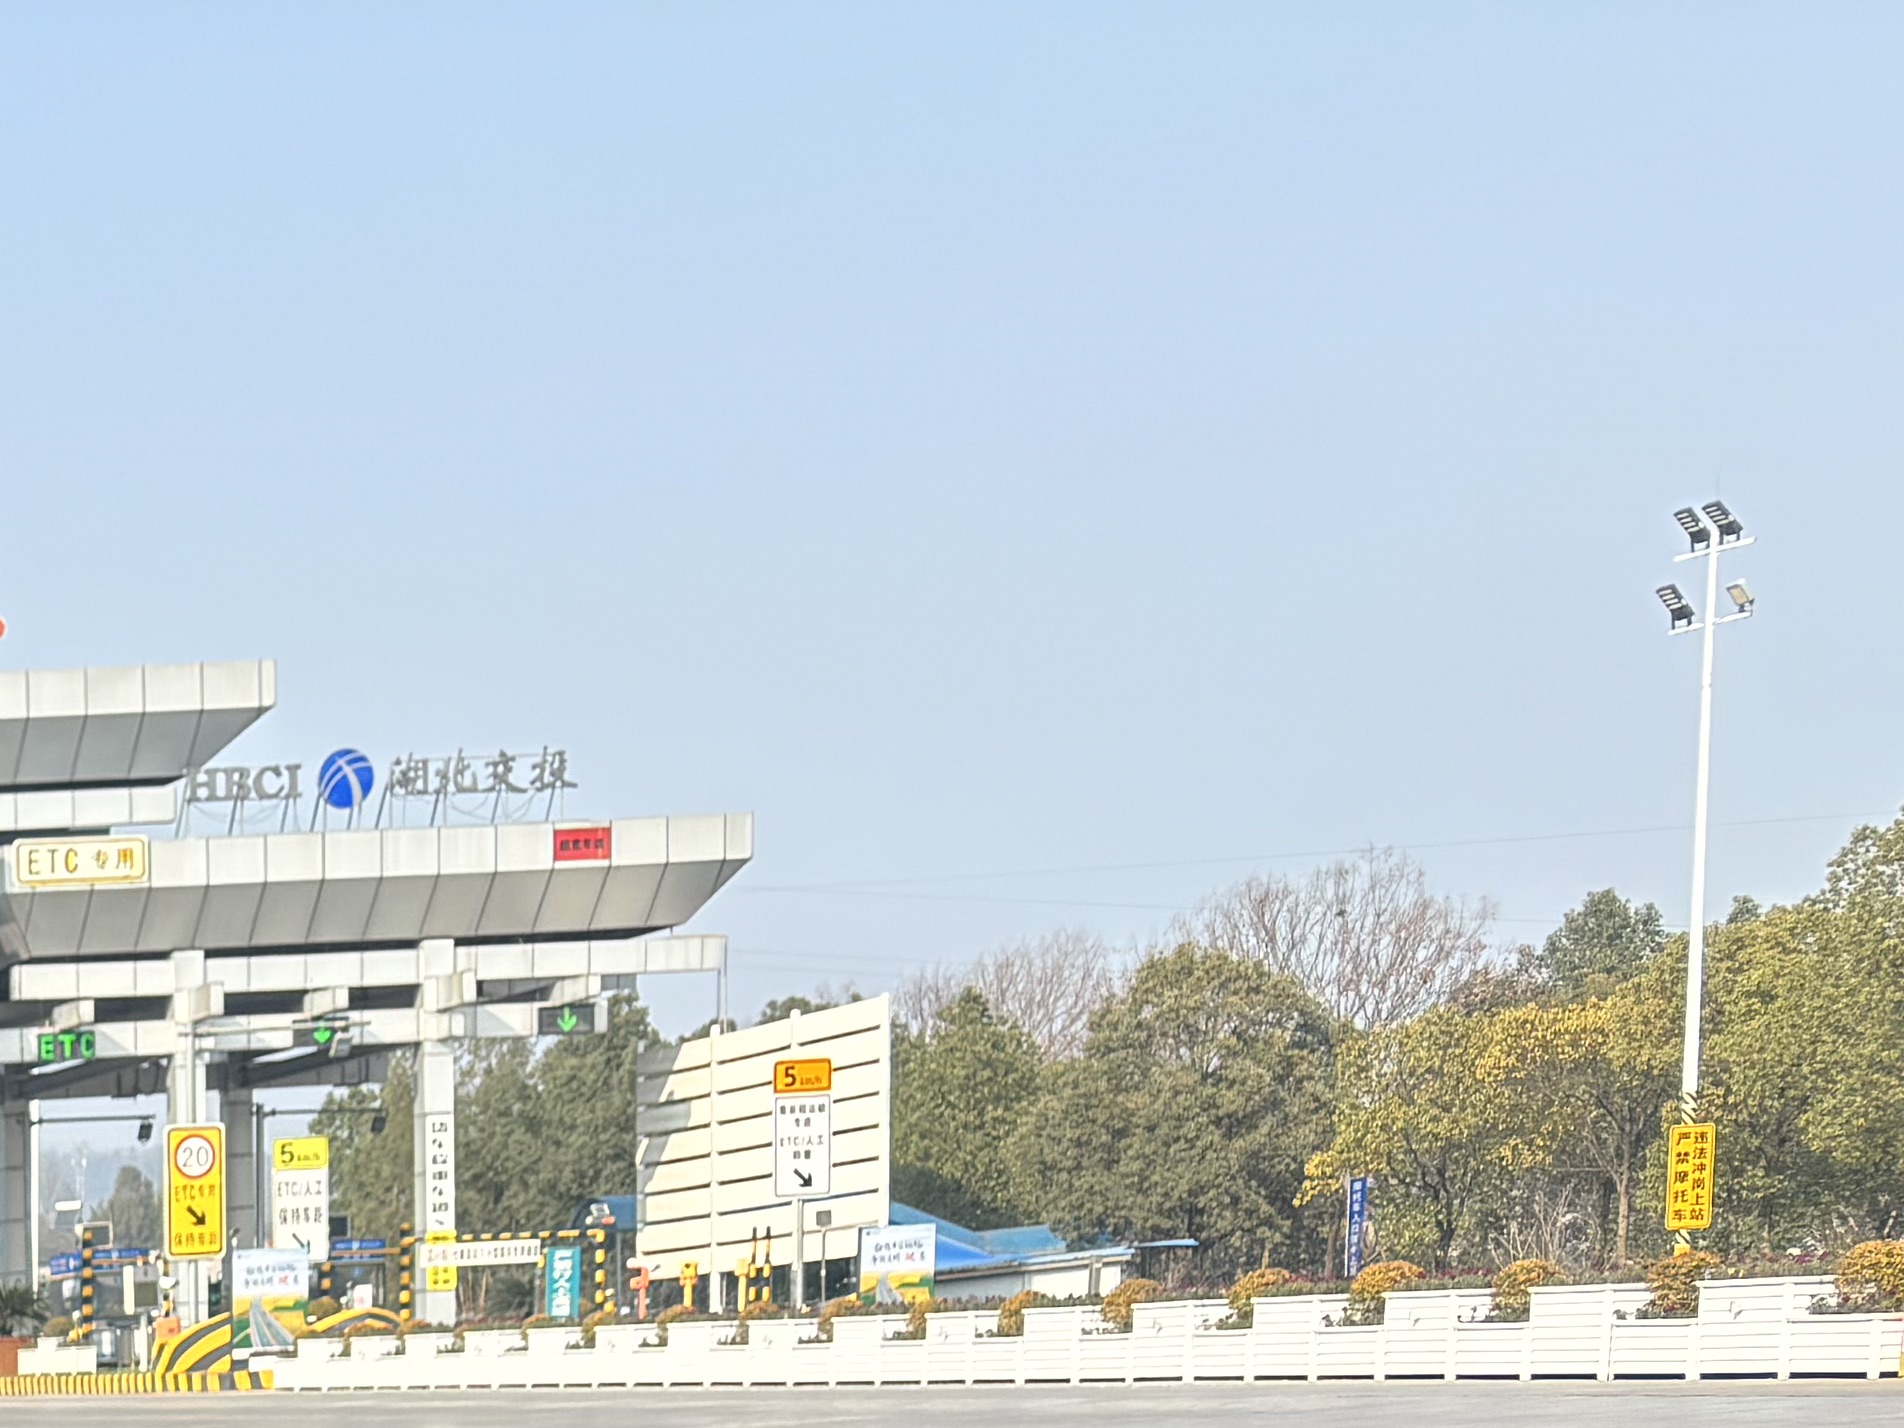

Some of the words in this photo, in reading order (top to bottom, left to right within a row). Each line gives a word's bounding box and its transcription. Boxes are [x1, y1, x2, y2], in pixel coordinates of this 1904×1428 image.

[185, 763, 303, 801] HBCI
[391, 745, 579, 796] 湖北交投
[28, 848, 79, 876] ETC
[40, 1032, 95, 1060] ETC
[784, 1065, 797, 1088] 5
[182, 1145, 209, 1168] 20
[280, 1142, 294, 1164] 5
[1672, 1132, 1692, 1222] 严禁摩托车
